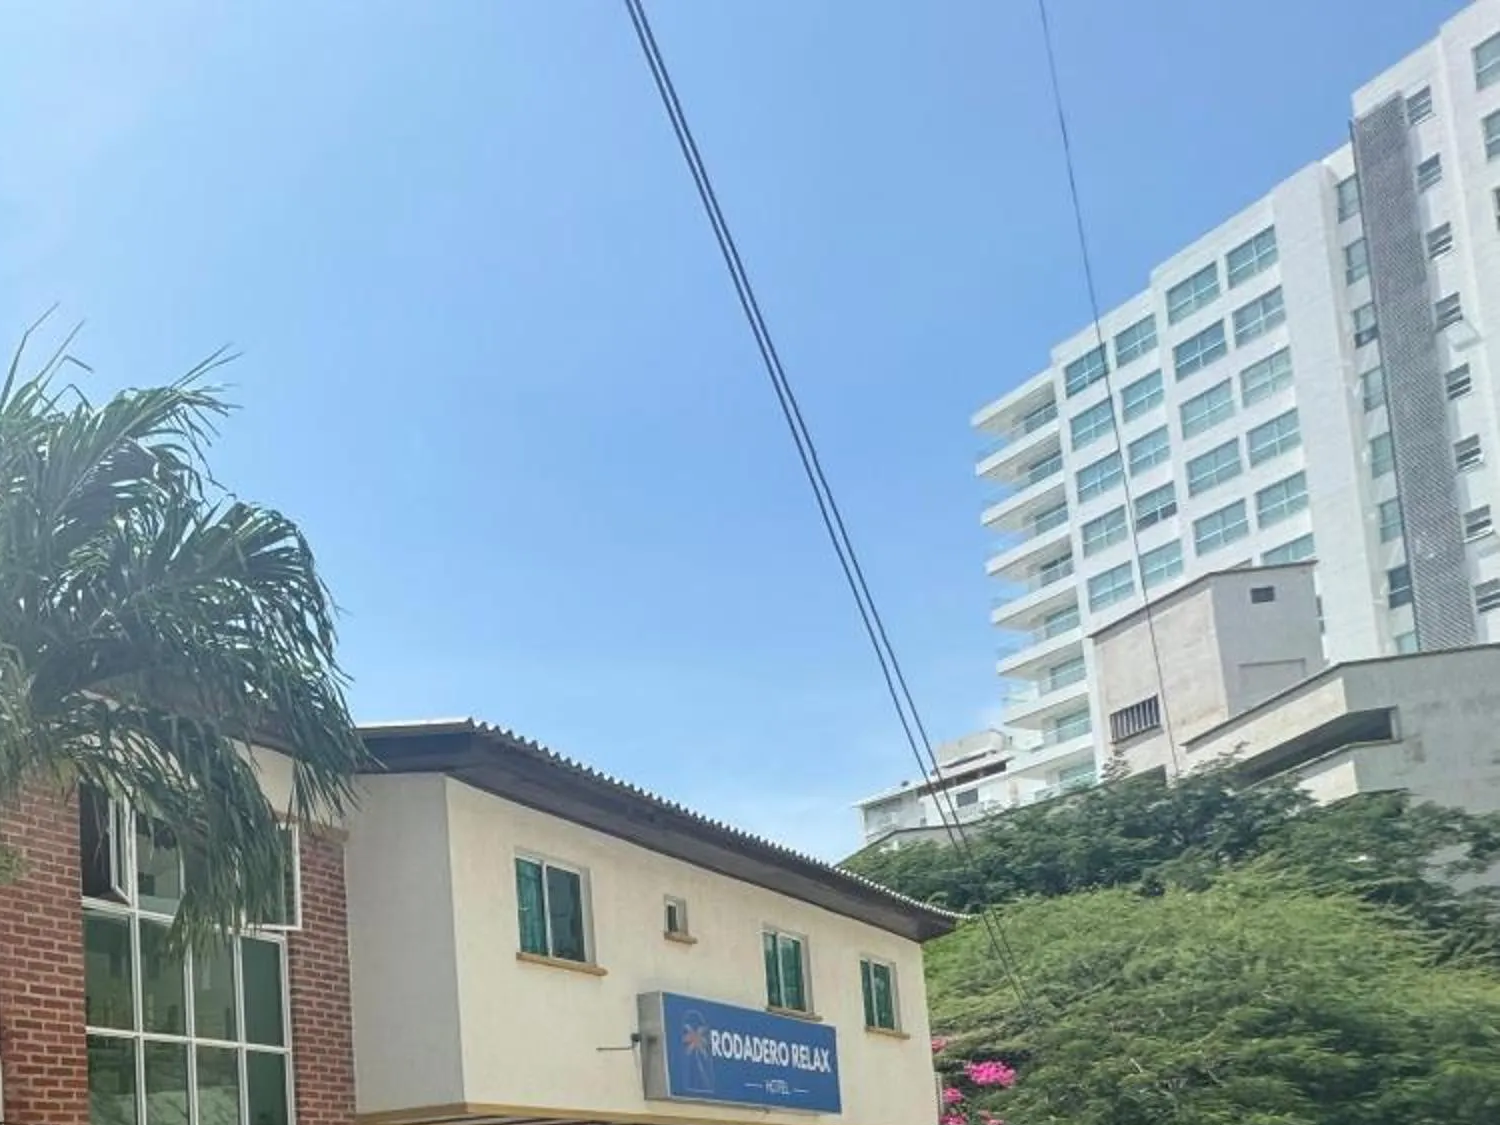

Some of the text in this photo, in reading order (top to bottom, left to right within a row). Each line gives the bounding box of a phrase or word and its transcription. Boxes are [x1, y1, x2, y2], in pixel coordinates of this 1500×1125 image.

[710, 1029, 831, 1072] RODADERO RELAX
[765, 1079, 790, 1095] HOTEL
